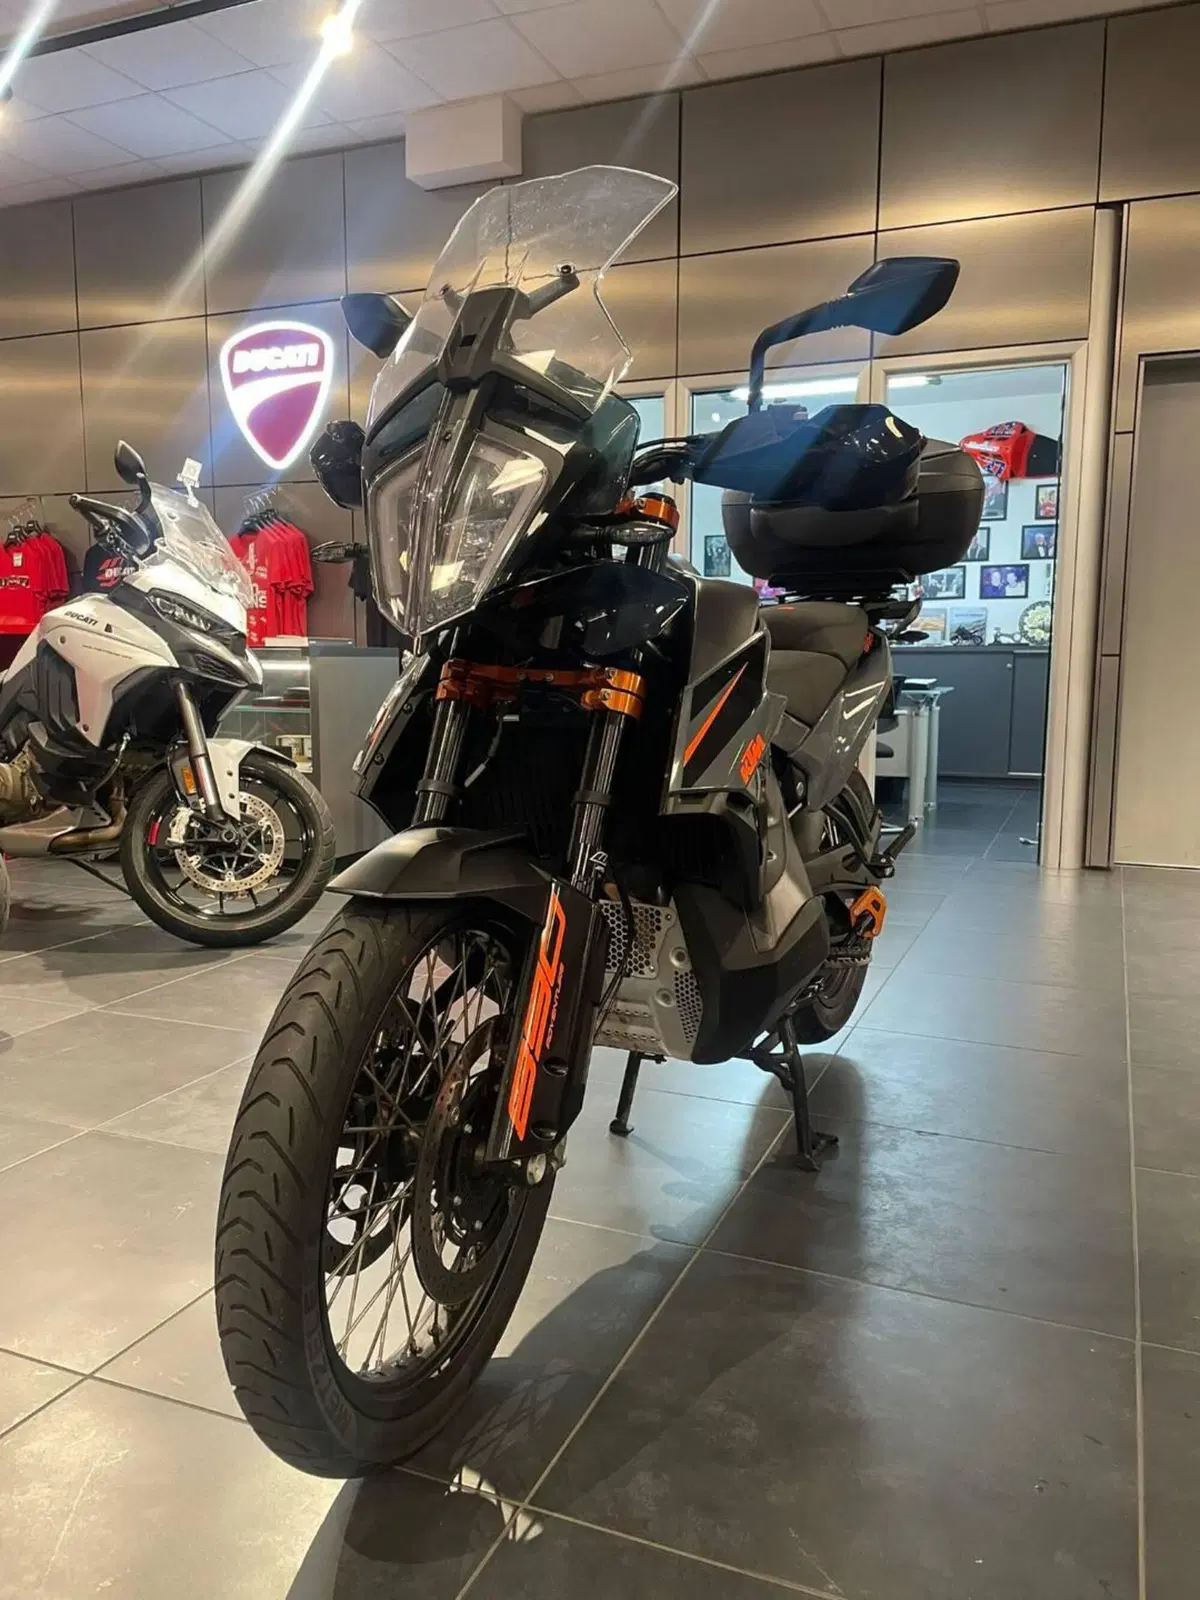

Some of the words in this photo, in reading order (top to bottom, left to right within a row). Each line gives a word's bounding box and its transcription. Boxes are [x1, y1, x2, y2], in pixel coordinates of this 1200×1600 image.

[232, 342, 320, 374] DUCATI
[64, 610, 99, 627] DUCATI
[507, 892, 567, 1142] 890
